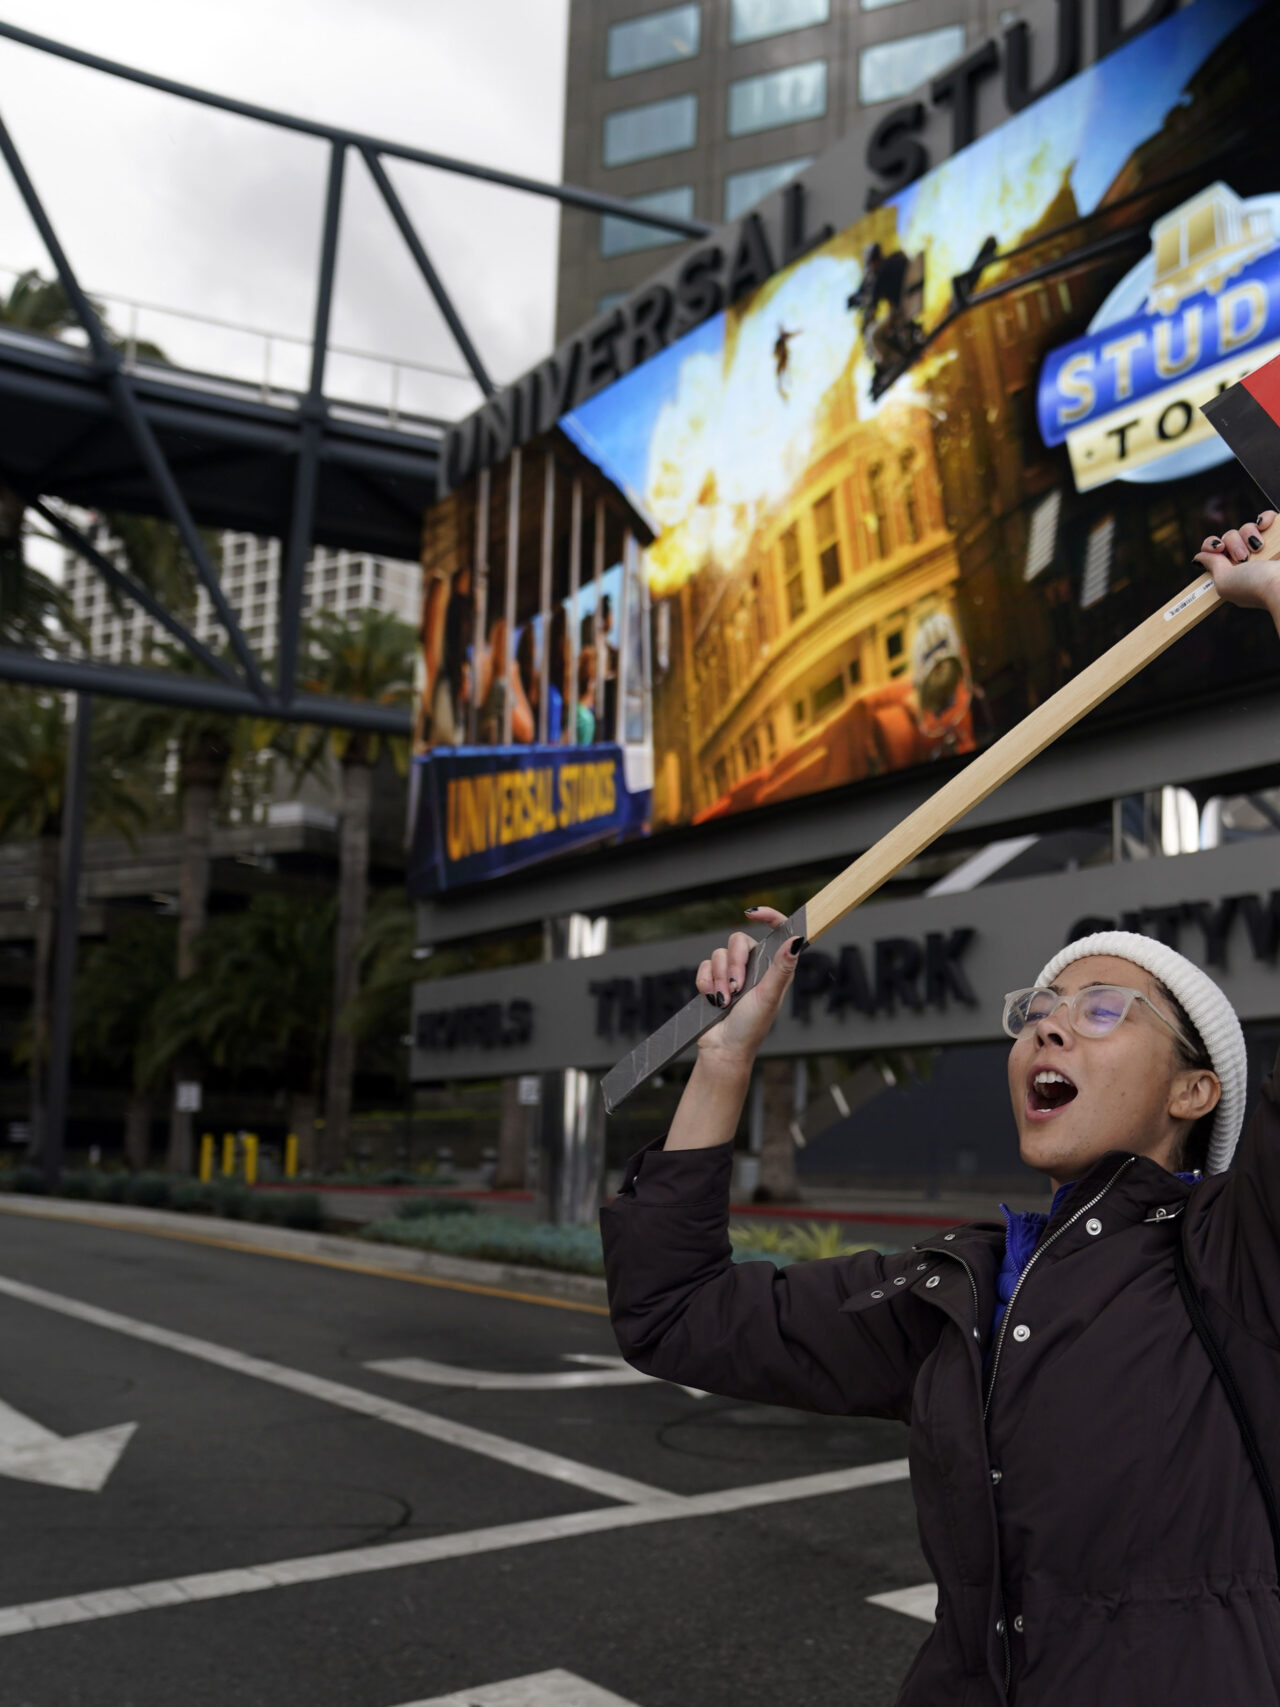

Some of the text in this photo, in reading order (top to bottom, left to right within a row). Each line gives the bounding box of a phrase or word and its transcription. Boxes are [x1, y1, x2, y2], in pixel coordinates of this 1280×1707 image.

[445, 183, 836, 485] UNIVERSAL
[1105, 368, 1252, 461] TO
[791, 926, 979, 1023] PARK
